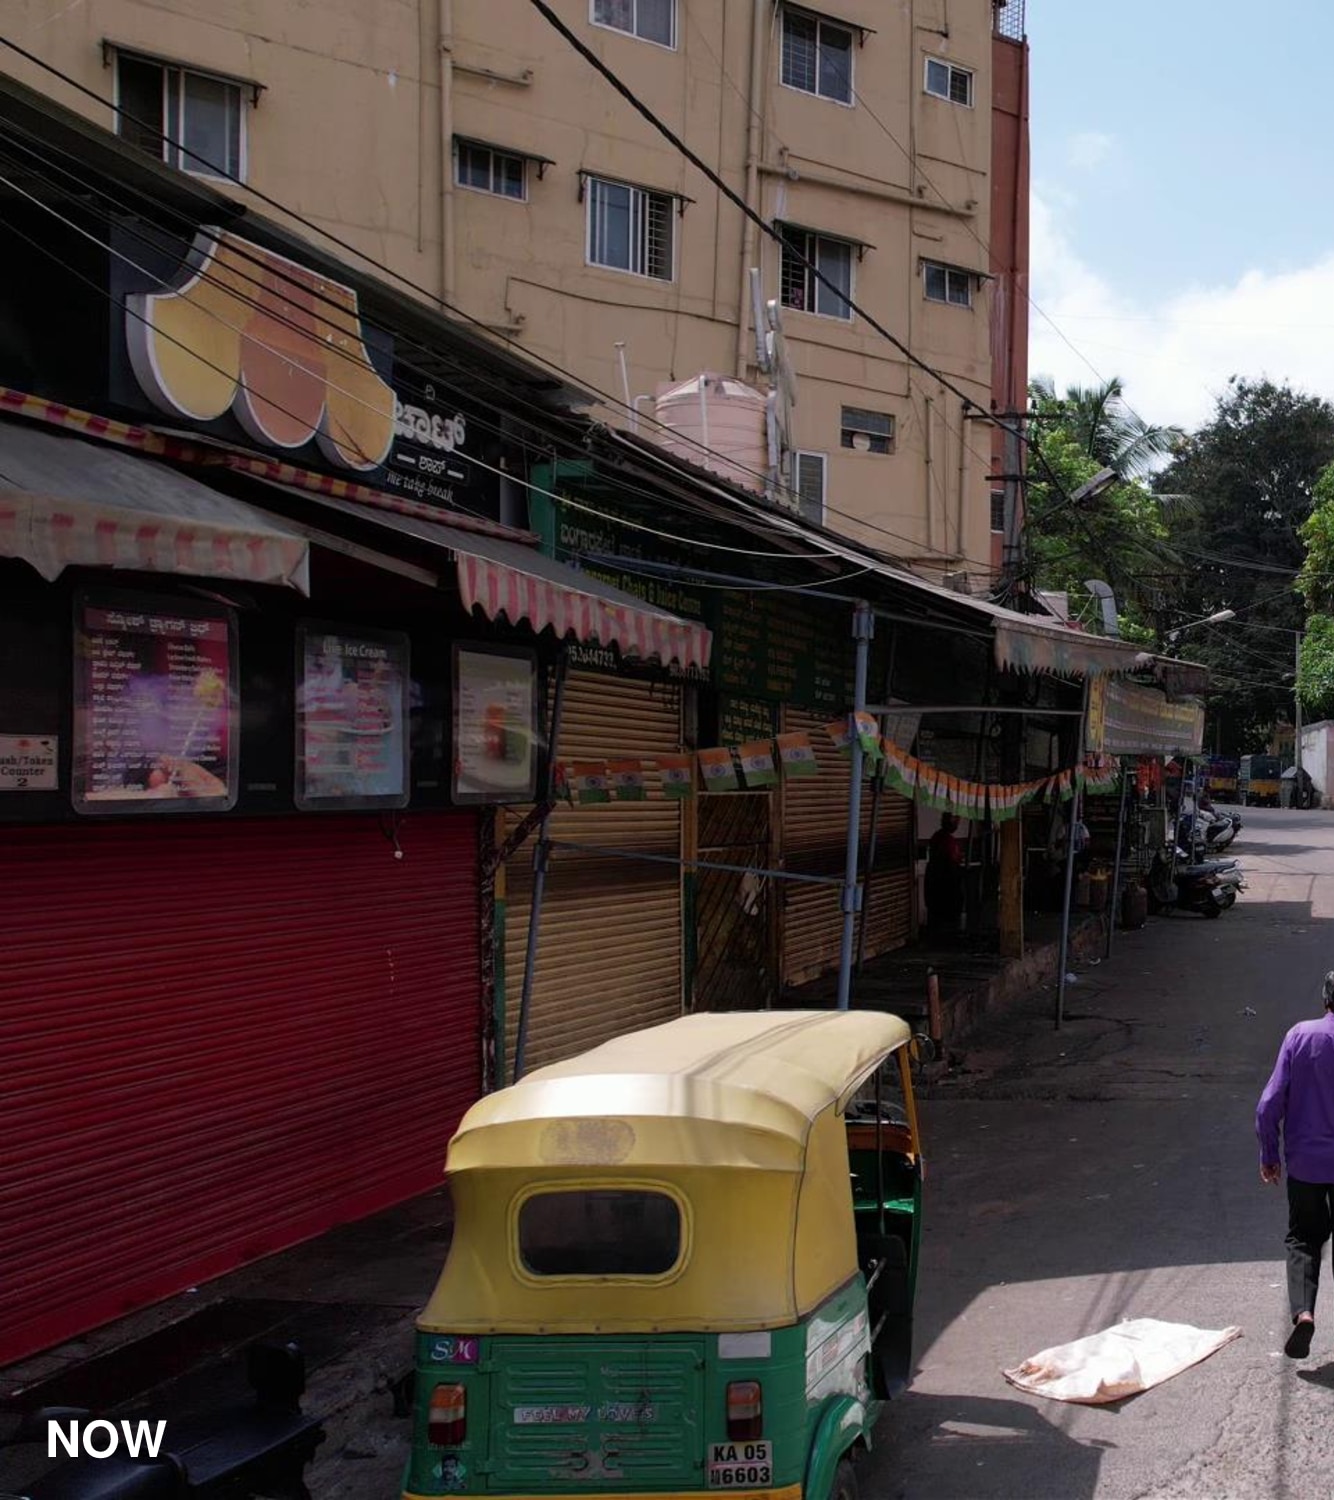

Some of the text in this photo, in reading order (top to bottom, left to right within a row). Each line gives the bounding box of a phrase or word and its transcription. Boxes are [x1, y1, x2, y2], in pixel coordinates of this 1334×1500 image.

[1, 766, 45, 776] Counter
[17, 778, 28, 787] 2
[714, 1444, 767, 1462] KA 05
[722, 1467, 770, 1485] 6603
